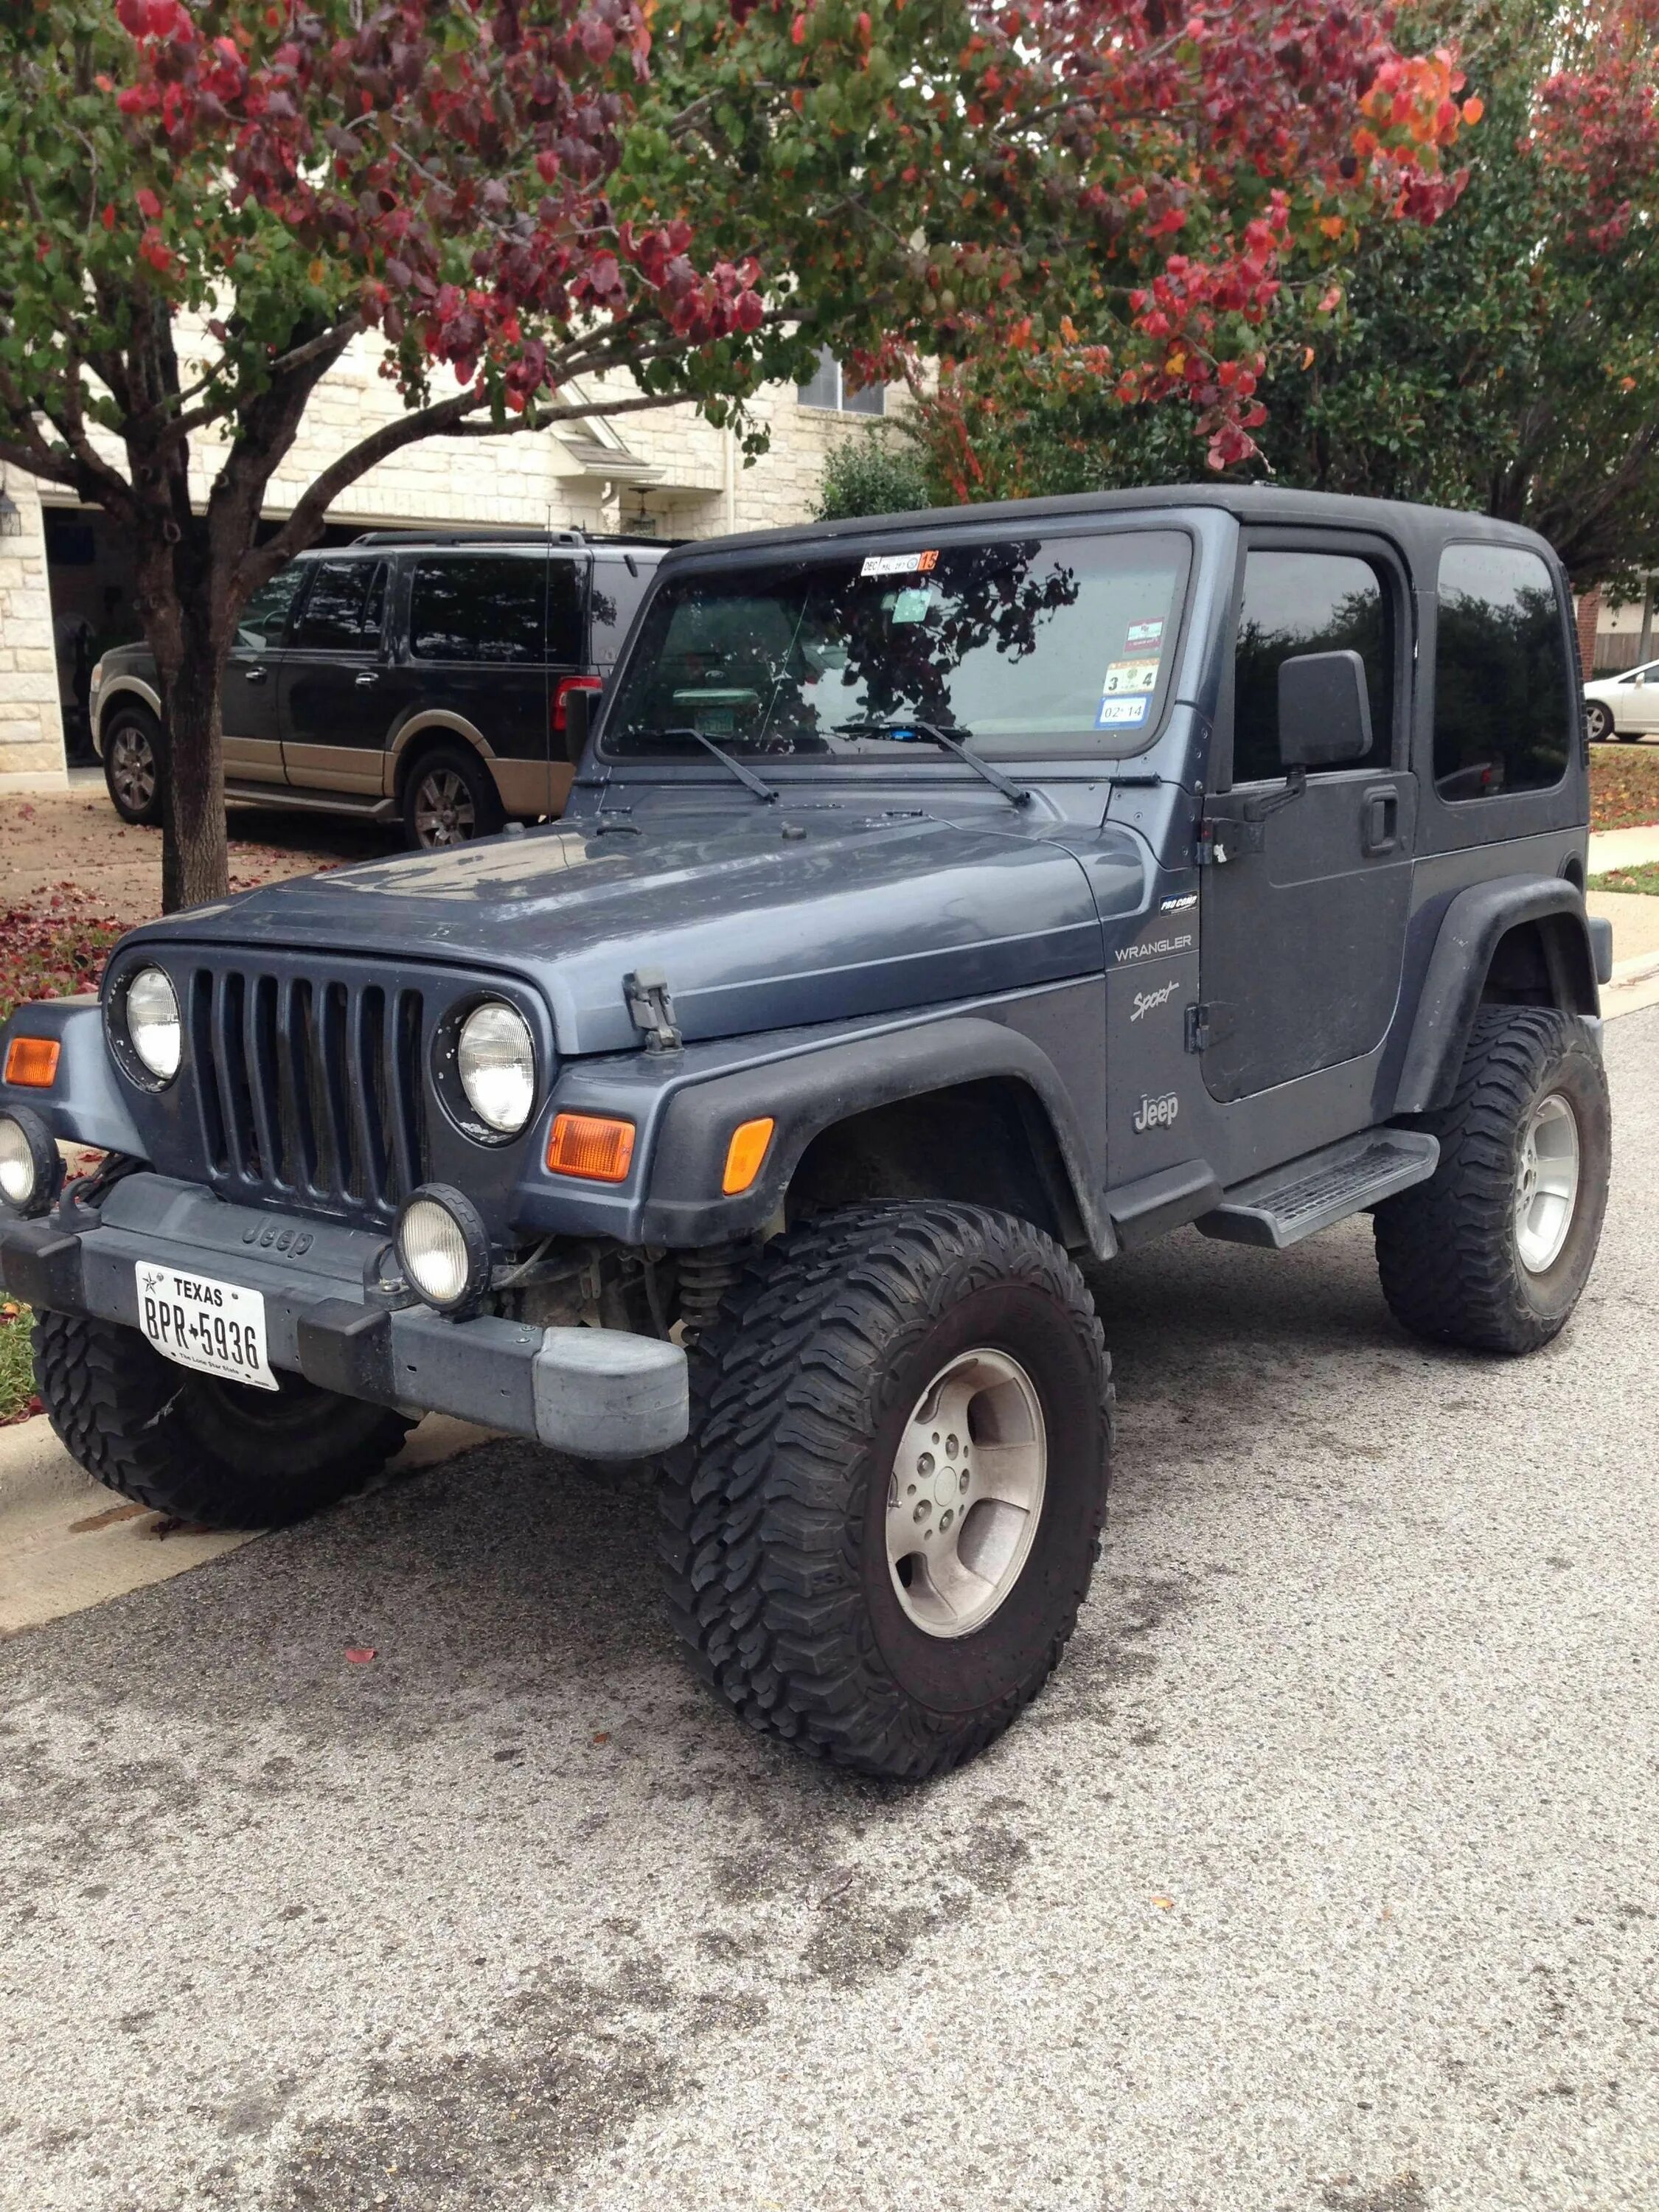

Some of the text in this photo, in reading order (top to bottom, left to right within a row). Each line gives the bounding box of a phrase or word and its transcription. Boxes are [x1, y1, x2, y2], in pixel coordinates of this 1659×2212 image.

[863, 560, 878, 571] DEC
[921, 554, 937, 569] 15
[1108, 677, 1119, 691] 3
[1161, 899, 1178, 911] PRO
[1175, 895, 1197, 908] COMP
[1115, 934, 1192, 962] WRANGLER
[1134, 1095, 1179, 1130] Jeep
[242, 1217, 315, 1259] Jeep
[173, 1277, 223, 1307] TEXAS
[178, 1352, 240, 1374] The Lone Star State
